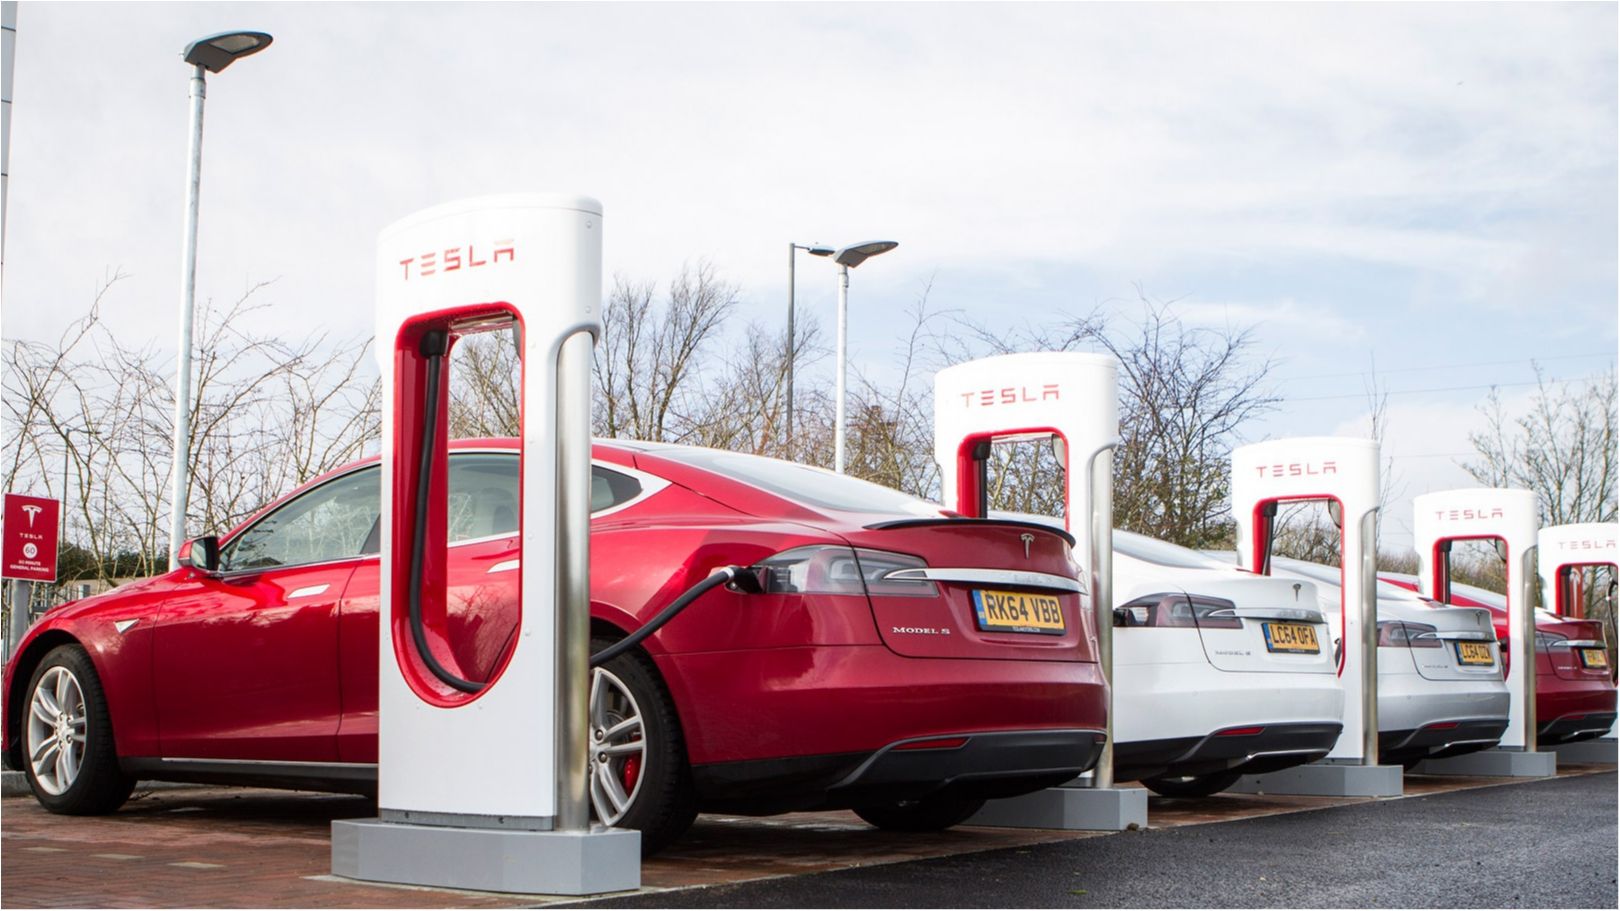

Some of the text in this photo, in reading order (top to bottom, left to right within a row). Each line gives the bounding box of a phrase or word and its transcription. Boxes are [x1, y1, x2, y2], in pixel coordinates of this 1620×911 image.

[400, 238, 515, 280] TESLA
[961, 384, 1059, 408] TESLA
[1255, 461, 1336, 478] TESLA
[1435, 508, 1503, 520] TESLA
[19, 532, 43, 540] TESLA
[25, 546, 35, 554] 60
[1558, 539, 1617, 550] TESLA
[9, 563, 30, 571] GENERAL
[985, 594, 1061, 624] RK64 VBB
[892, 626, 939, 634] MODEL
[1270, 625, 1297, 644] LC64
